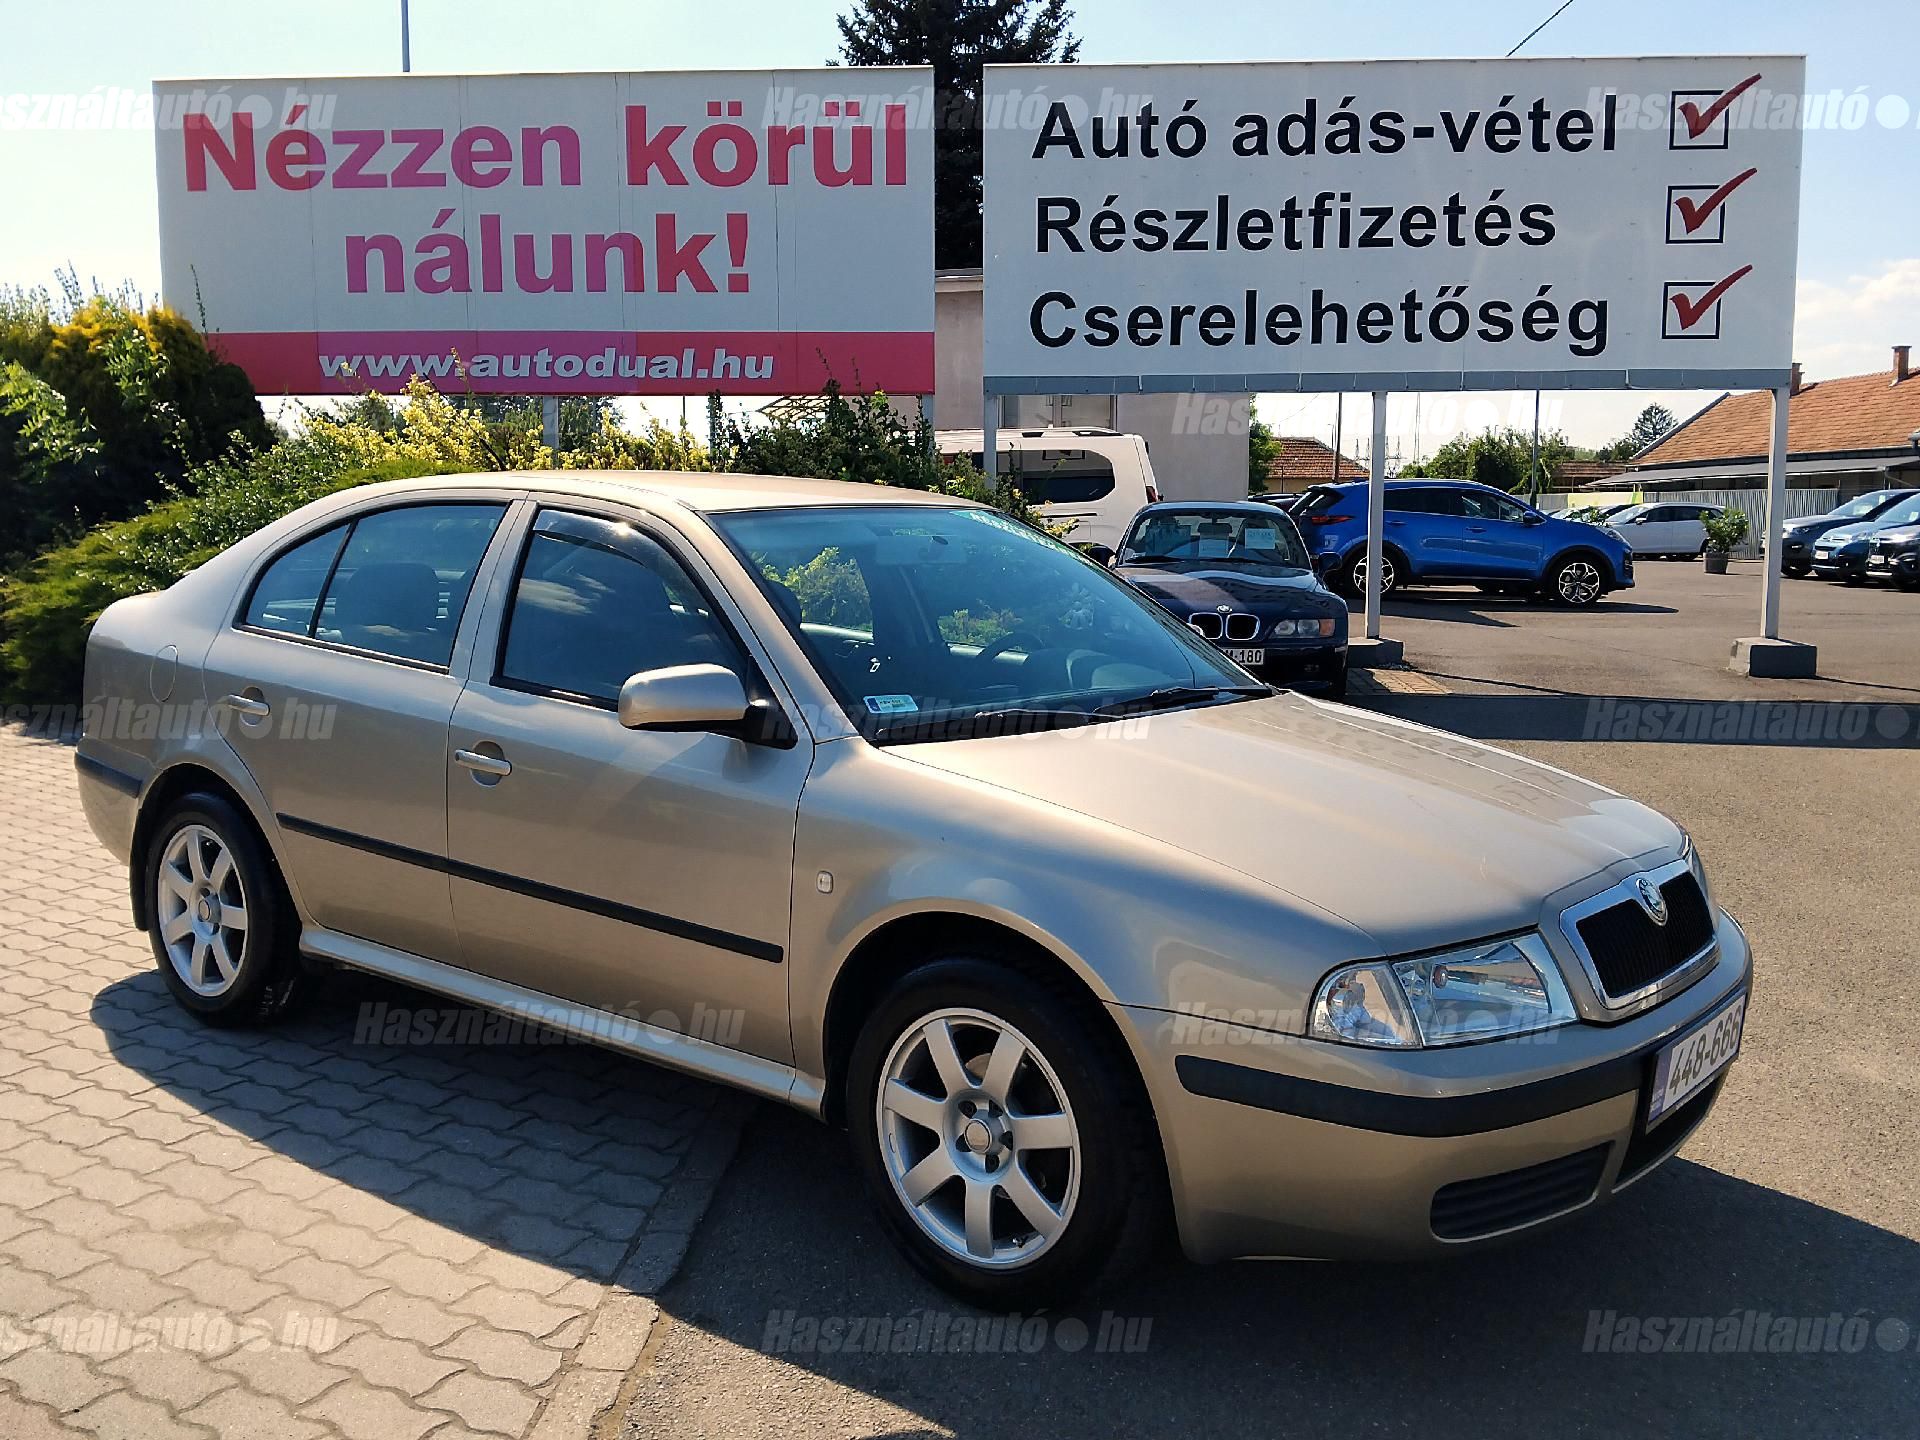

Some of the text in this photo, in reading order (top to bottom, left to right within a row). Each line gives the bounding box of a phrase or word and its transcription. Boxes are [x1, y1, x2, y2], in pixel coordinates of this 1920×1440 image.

[183, 101, 908, 192] Nézzen körül
[1032, 94, 1617, 160] Autó adás-vétel
[346, 209, 750, 294] nálunk!
[1038, 188, 1557, 254] Részletfizetés
[1030, 284, 1609, 357] Cserelehetőség
[318, 347, 775, 380] www.autodual.hu
[1668, 1004, 1742, 1096] 448-666
